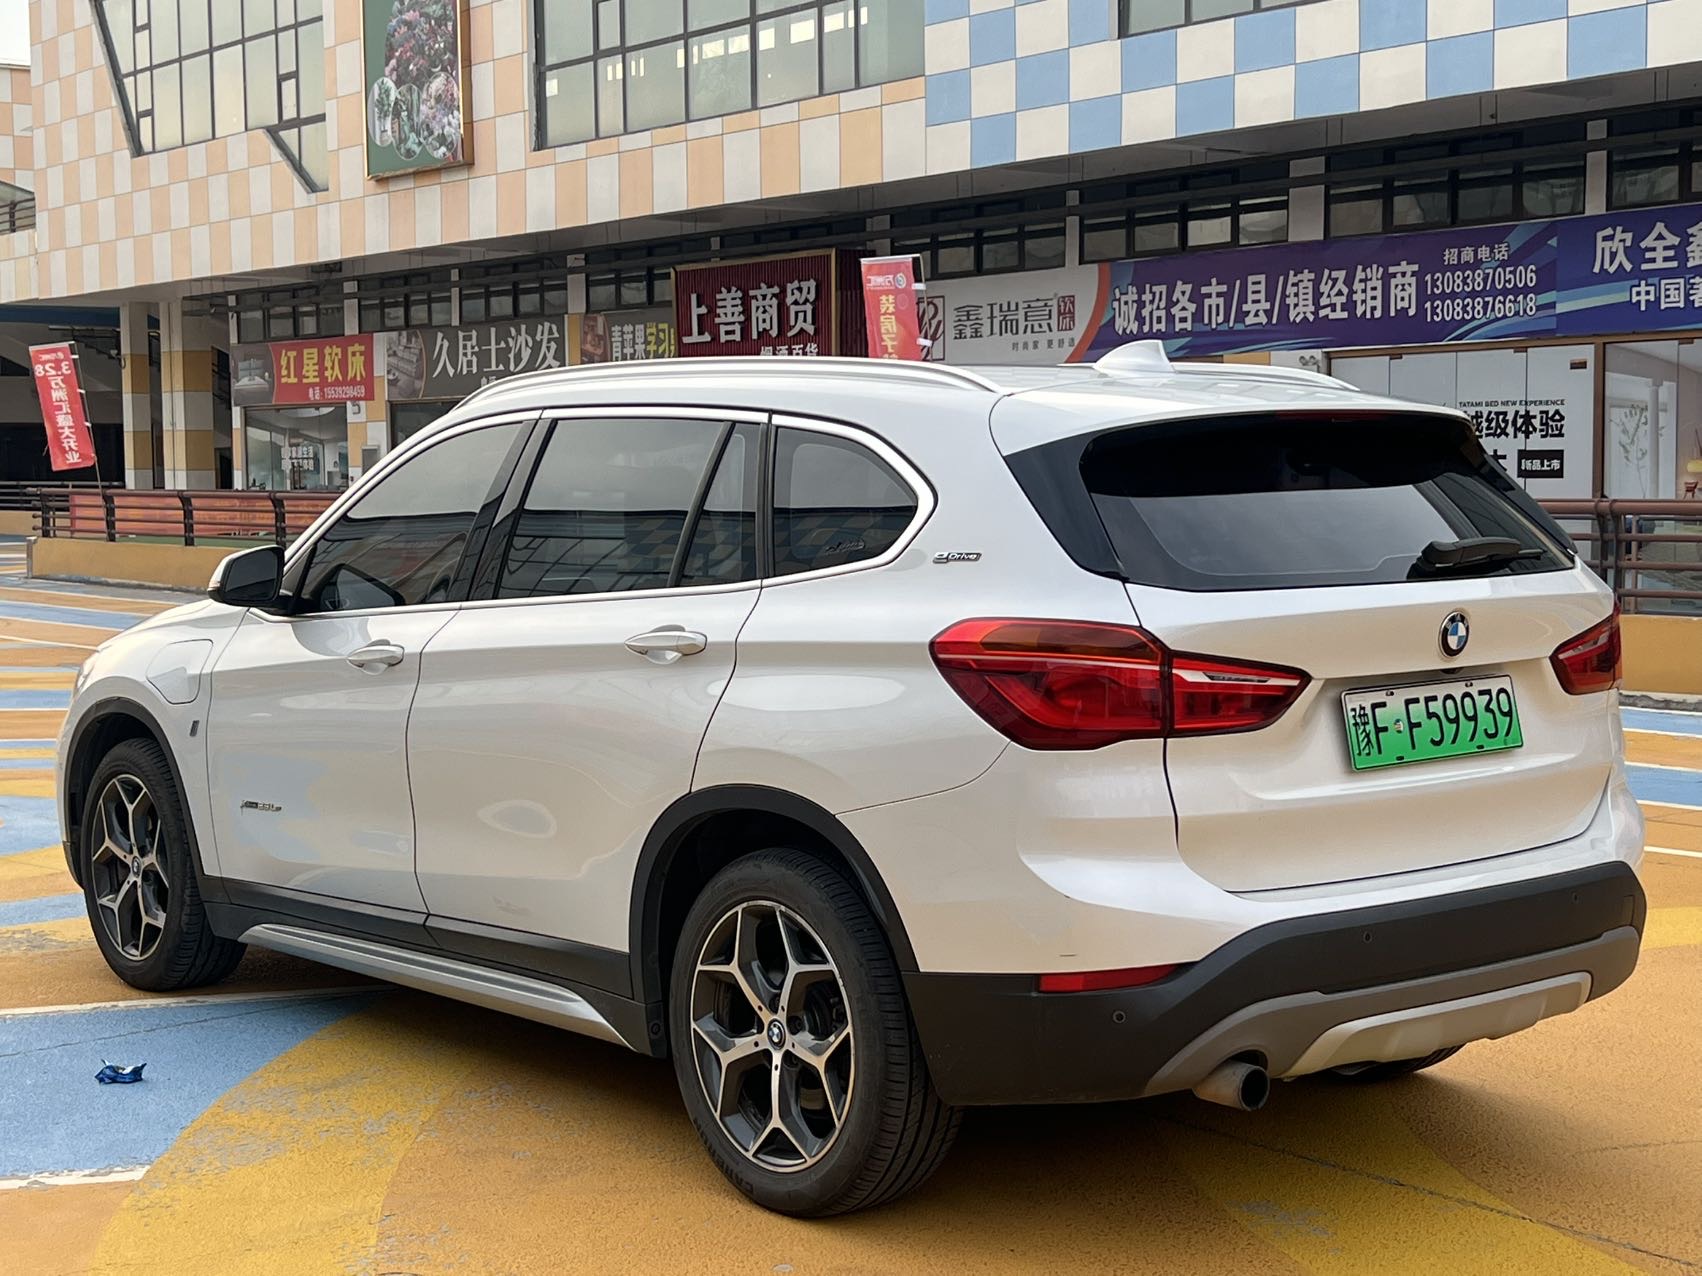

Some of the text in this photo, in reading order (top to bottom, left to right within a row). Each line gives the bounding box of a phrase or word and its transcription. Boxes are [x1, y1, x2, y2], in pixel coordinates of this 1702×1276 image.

[1443, 242, 1510, 266] 招商电话
[1112, 260, 1420, 336] 诚招各市/县/镇经销商
[1424, 264, 1537, 295] 13083870506
[681, 278, 817, 344] 上善商贸
[953, 298, 1054, 340] 鑫瑞意
[1424, 293, 1536, 322] 13083876618
[432, 321, 561, 379] 久居士沙发
[611, 322, 675, 361] 青苹果学习
[280, 343, 366, 384] 红星软床
[1501, 399, 1517, 407] NEW
